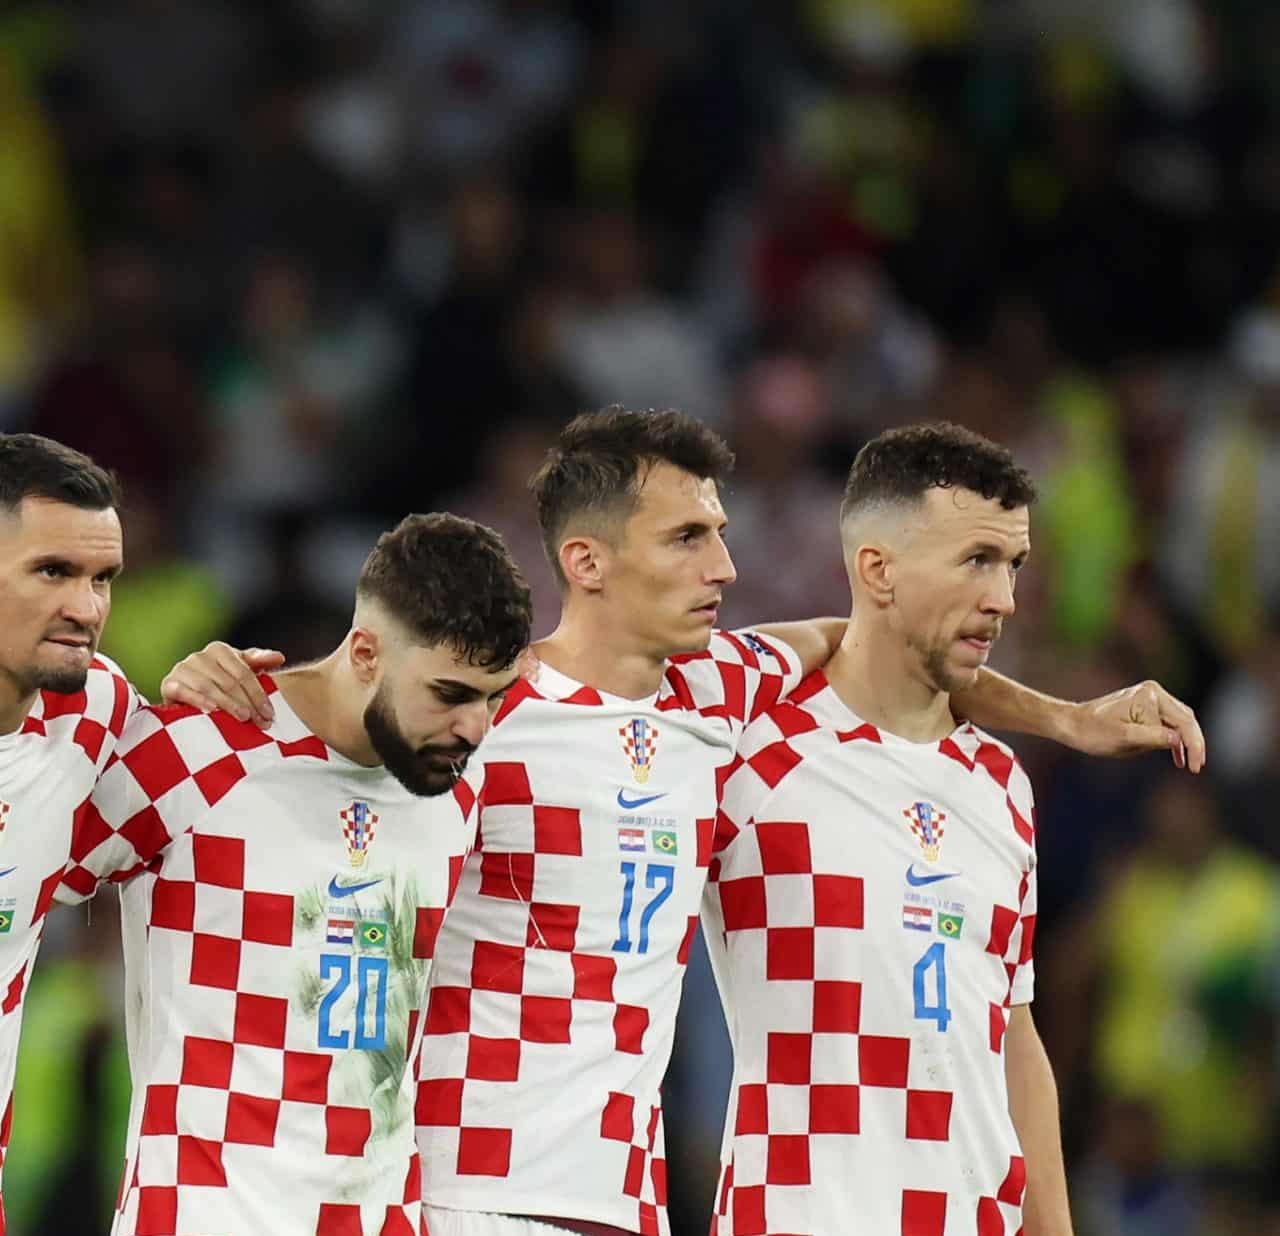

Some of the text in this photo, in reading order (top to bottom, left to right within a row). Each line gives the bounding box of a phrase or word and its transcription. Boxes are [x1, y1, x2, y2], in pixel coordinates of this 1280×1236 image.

[612, 862, 674, 954] 17
[318, 954, 389, 1051] 20
[913, 942, 952, 1033] 4
